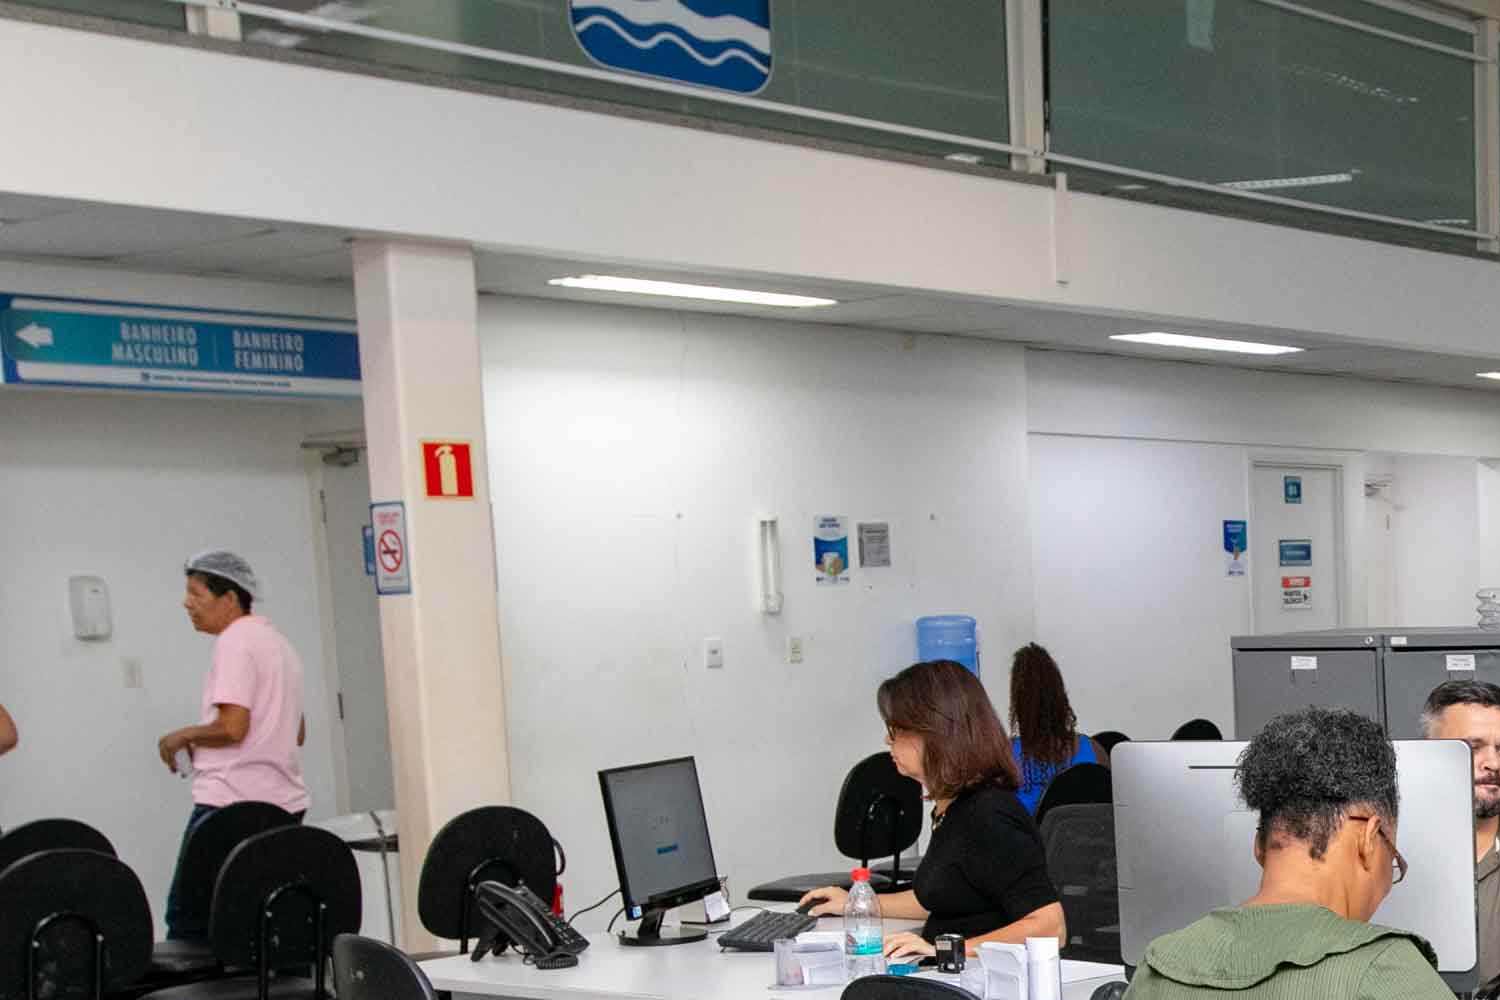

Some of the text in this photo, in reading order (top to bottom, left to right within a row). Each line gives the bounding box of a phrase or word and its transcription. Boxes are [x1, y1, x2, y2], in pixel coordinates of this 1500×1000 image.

[121, 321, 304, 352] BANHEIRO BANHEIRO
[111, 341, 304, 372] MASCULINO FEMININO
